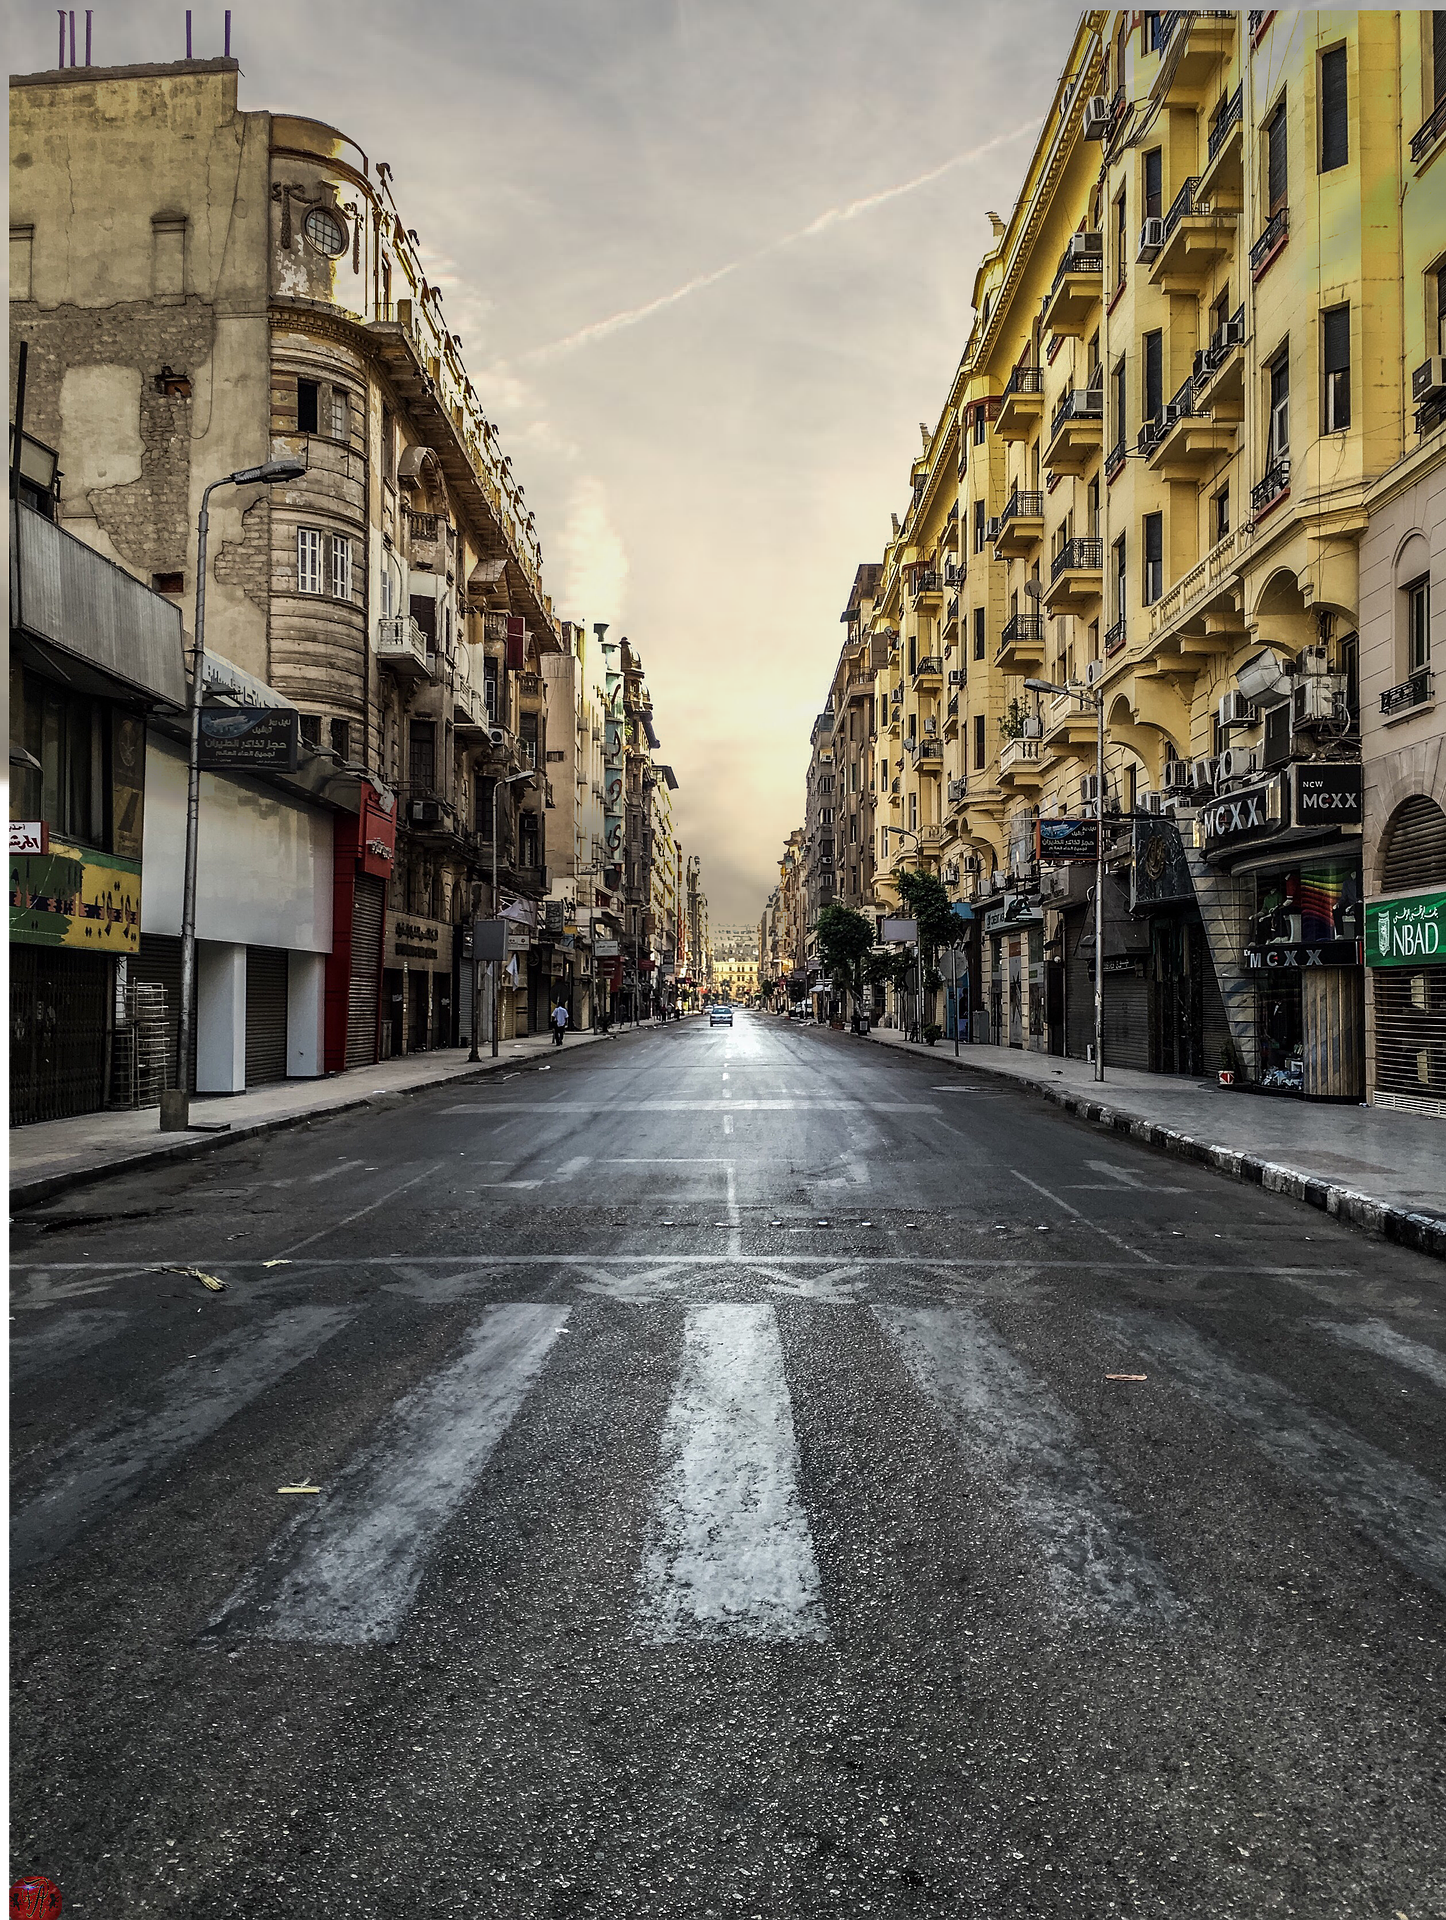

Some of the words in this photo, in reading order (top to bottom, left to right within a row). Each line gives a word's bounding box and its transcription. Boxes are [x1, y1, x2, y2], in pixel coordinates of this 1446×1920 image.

[205, 738, 239, 749] الطيران
[241, 739, 265, 749] تذاكر
[266, 740, 287, 750] حجز
[1393, 921, 1439, 957] NBAD
